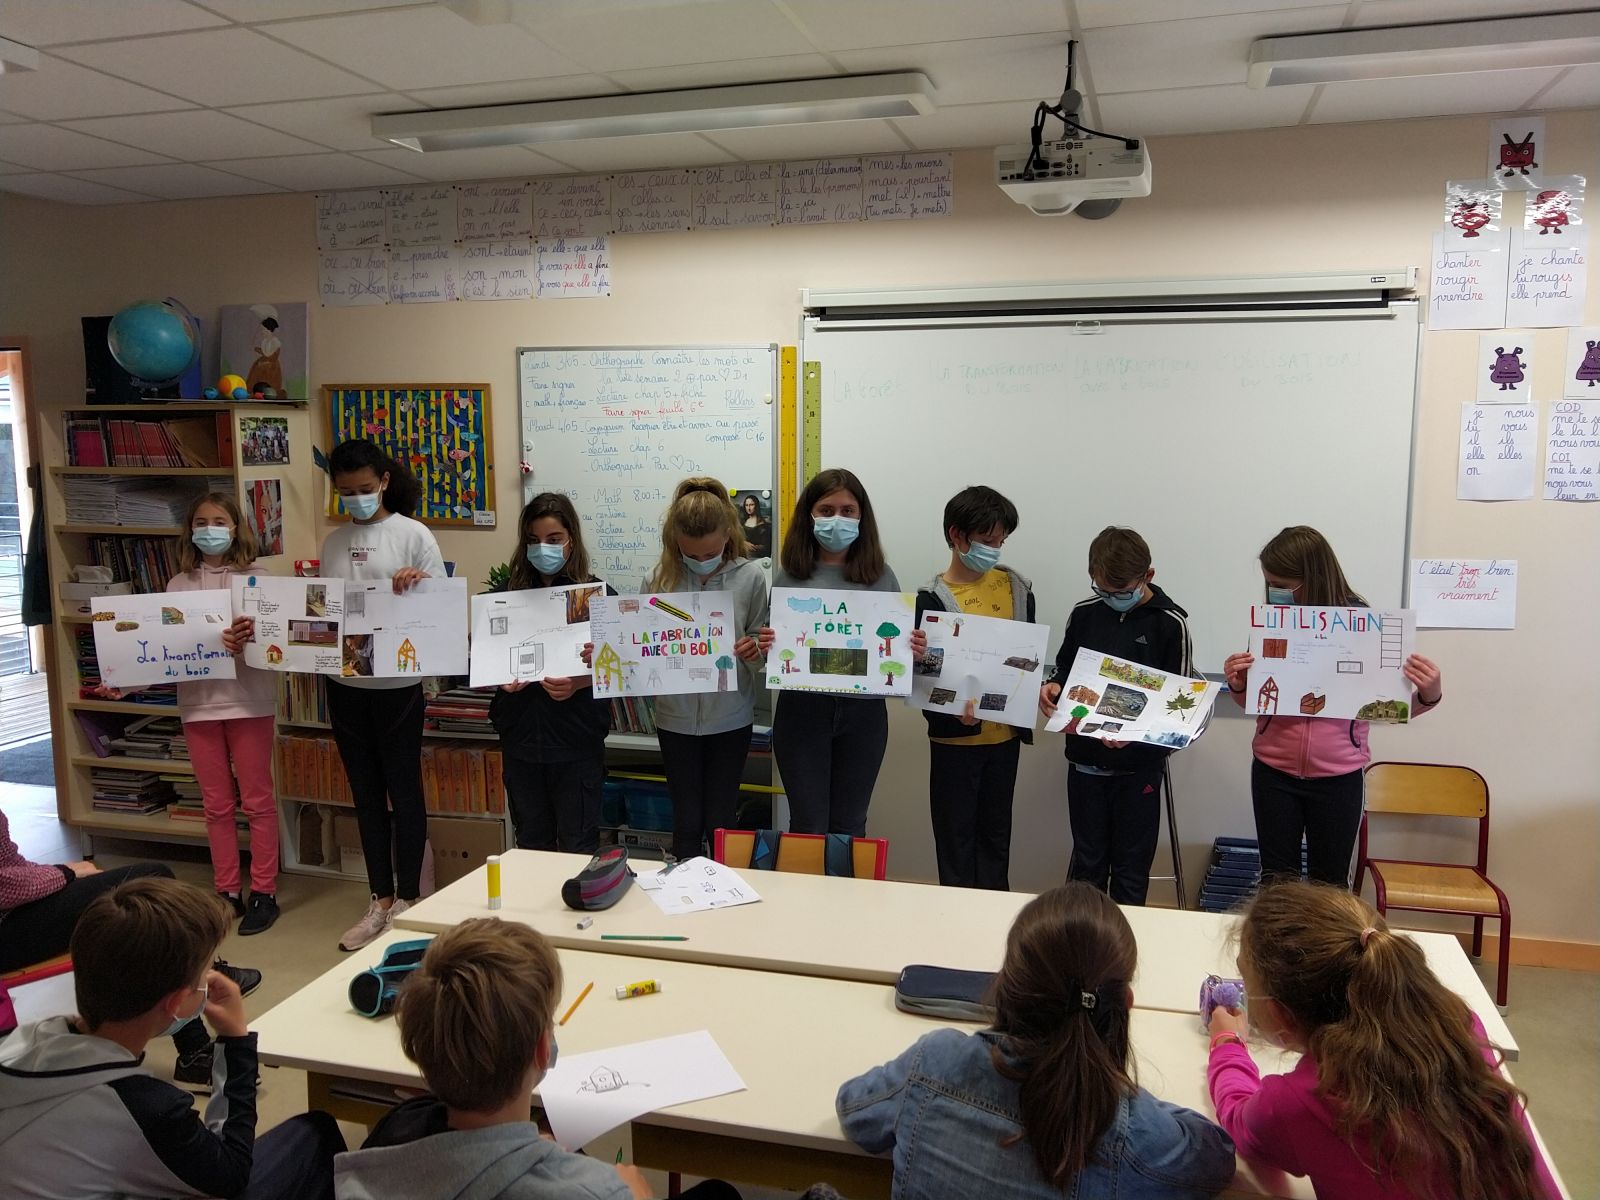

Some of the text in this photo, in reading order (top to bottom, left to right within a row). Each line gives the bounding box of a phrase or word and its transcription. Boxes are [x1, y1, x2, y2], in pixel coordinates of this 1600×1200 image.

[1436, 252, 1483, 270] chanter
[1518, 249, 1585, 275] je chante
[1435, 275, 1479, 292] rougir
[1512, 269, 1573, 290] tu rougis
[1433, 287, 1484, 312] prendre
[1510, 283, 1573, 308] elle prend
[601, 405, 625, 417] Faire
[1555, 402, 1581, 413] COD
[1472, 408, 1535, 425] je nous
[1551, 415, 1574, 424] me
[1575, 412, 1588, 424] te
[715, 419, 731, 429] au
[1464, 420, 1529, 433] tu vous
[1551, 423, 1586, 437] le la
[1467, 430, 1515, 447] il ils
[1549, 439, 1579, 448] nous
[1466, 445, 1523, 461] elle elles
[1551, 452, 1571, 462] COI
[1466, 466, 1481, 477] on
[1547, 462, 1592, 475] me te se
[1544, 480, 1593, 488] nous vous
[1553, 487, 1599, 500] leur en
[1453, 576, 1477, 590] très
[1437, 590, 1500, 602] vraiment
[823, 602, 848, 615] LA
[632, 632, 651, 645] LA
[641, 643, 669, 657] AVEC
[671, 643, 687, 655] DU
[165, 664, 211, 677] du bois
